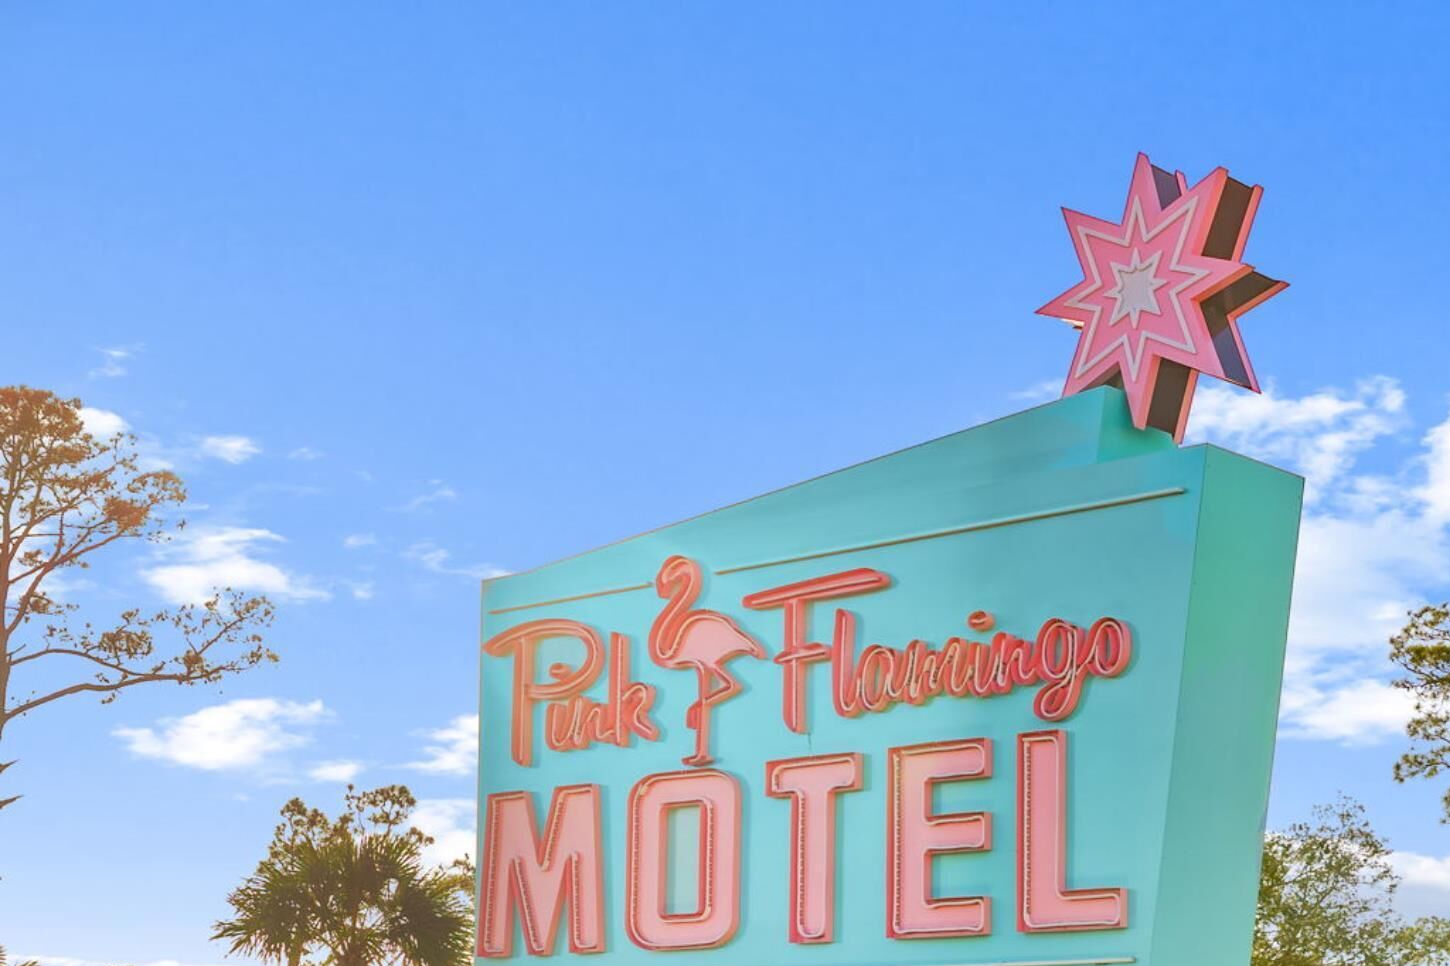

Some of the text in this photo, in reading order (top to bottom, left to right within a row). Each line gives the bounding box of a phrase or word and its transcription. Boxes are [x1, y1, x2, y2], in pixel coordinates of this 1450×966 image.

[482, 567, 1133, 767] Pink Flamingo
[477, 729, 1129, 957] MOTEL
